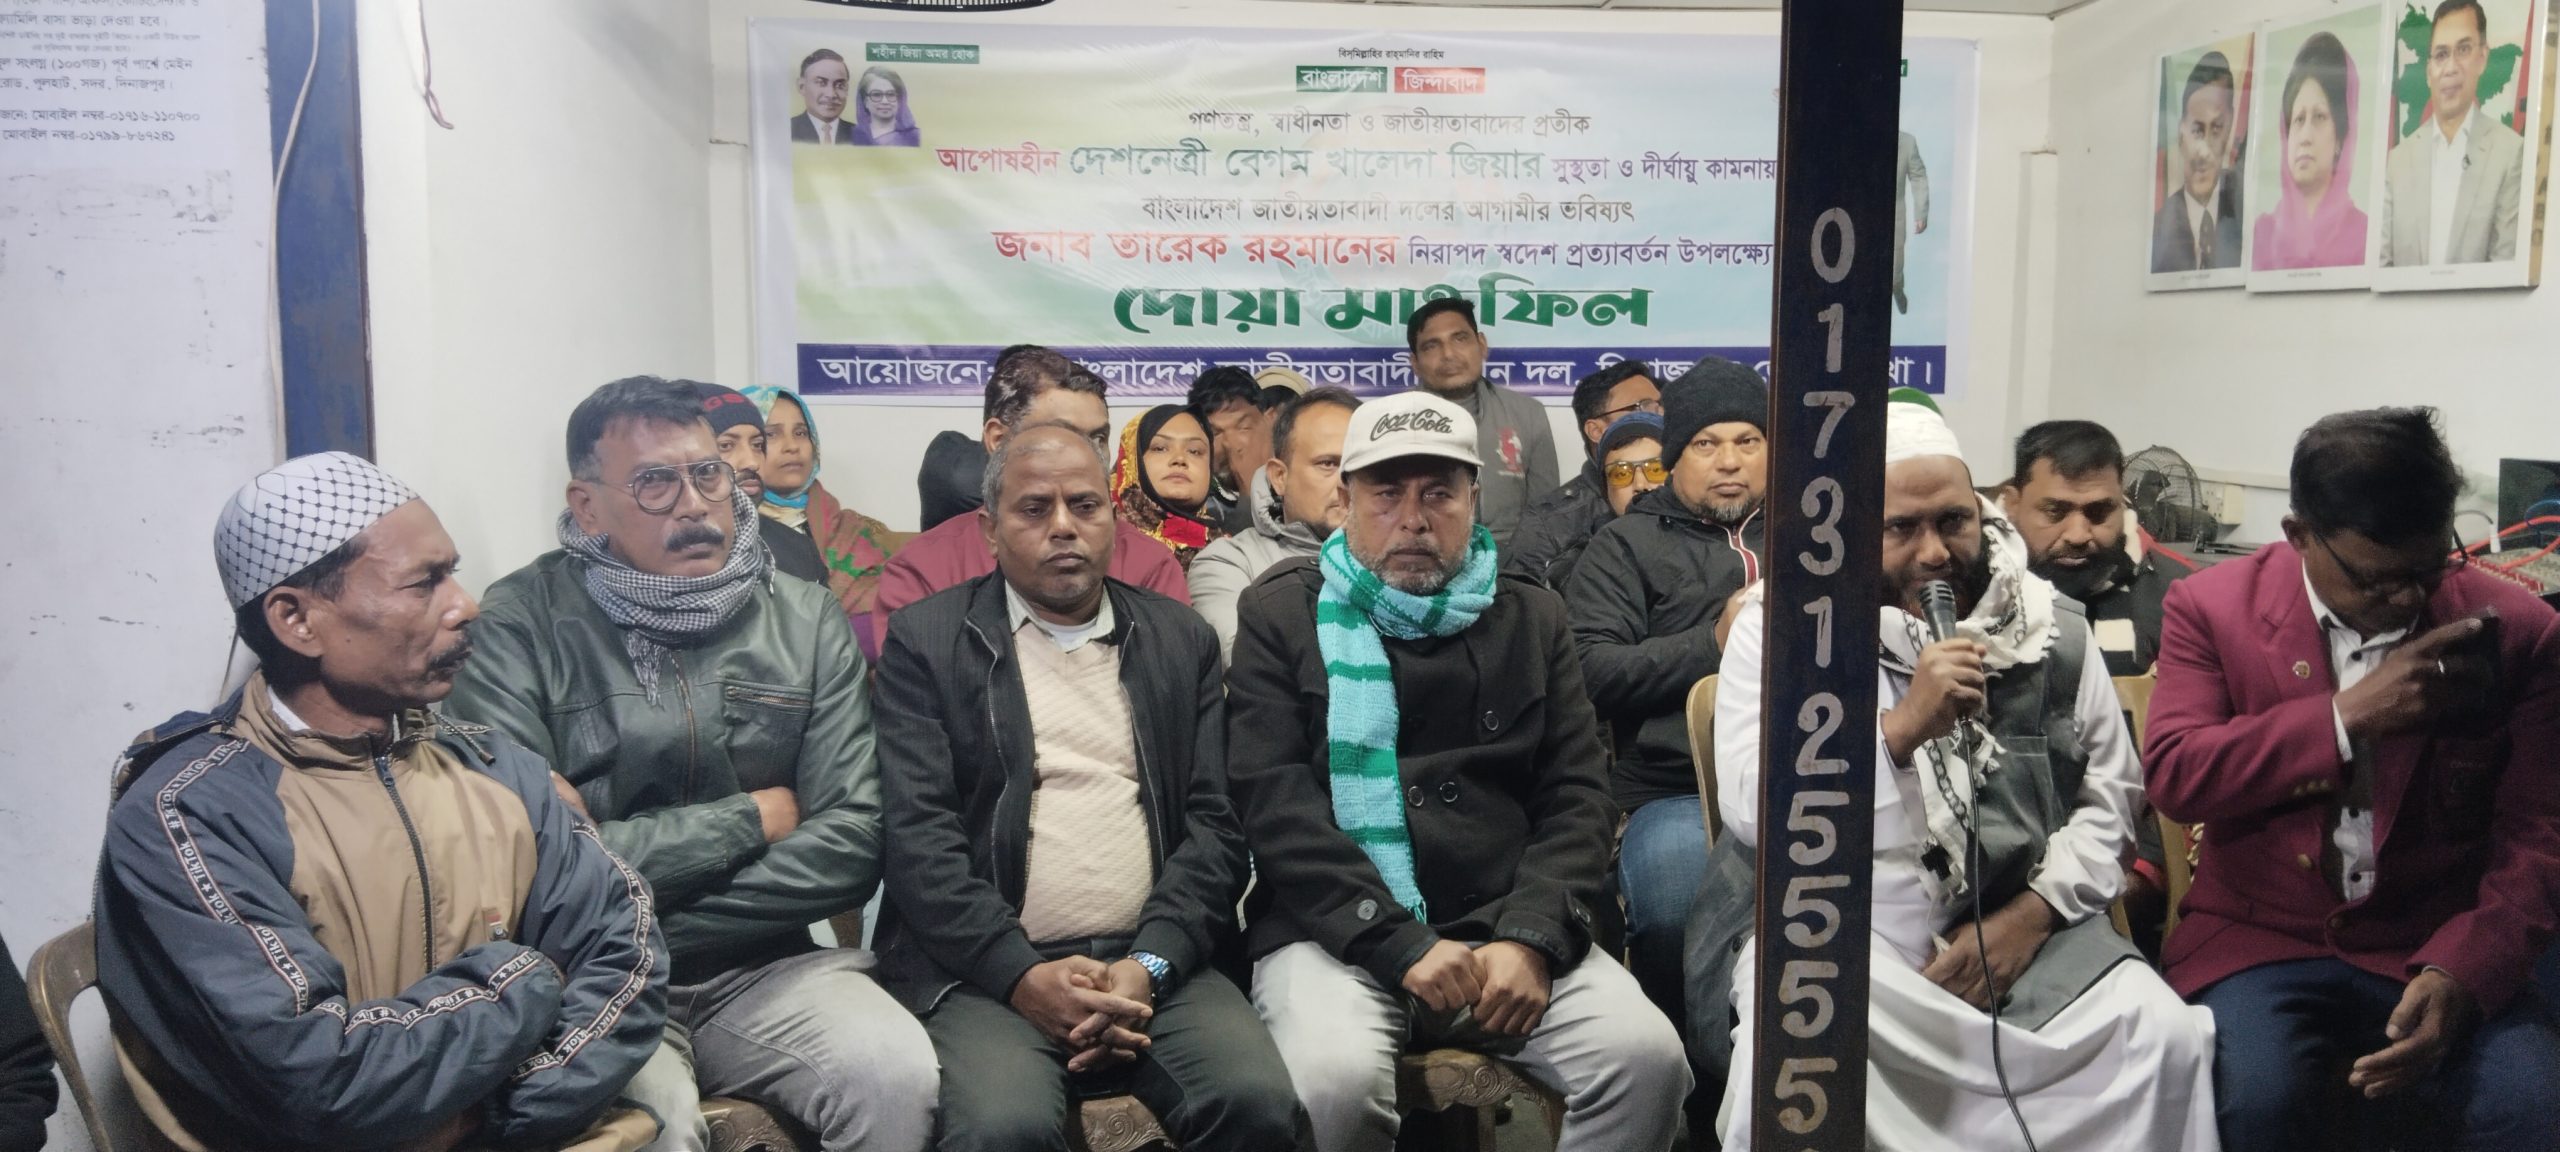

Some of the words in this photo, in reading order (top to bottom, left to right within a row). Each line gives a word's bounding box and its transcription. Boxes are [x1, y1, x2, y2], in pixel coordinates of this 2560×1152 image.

[164, 57, 192, 70] মেইন
[871, 44, 897, 59] শহীদ
[925, 48, 948, 60] অমর
[1300, 68, 1383, 90] বাংলাদেশ
[1402, 68, 1479, 92] জিন্দাবাদ
[33, 108, 77, 120] মোবাইল
[1189, 112, 1260, 137] গণতন্ত্র,
[1271, 108, 1351, 134] স্বাধীনতা
[1360, 115, 1376, 134] ও
[1384, 108, 1525, 135] জাতীয়তাবাদের
[1534, 108, 1592, 137] প্রতীক
[3, 127, 47, 140] মোবাইল
[936, 142, 1061, 176] আপোষহীন
[1069, 138, 1212, 176] দেশনেত্রী
[1226, 147, 1313, 179] বেগম
[1327, 148, 1437, 180] খালেদা
[1446, 142, 1545, 180] জিয়ার
[1551, 157, 1610, 184] সুস্থতা
[1617, 160, 1634, 178] ও
[1641, 151, 1699, 185] দীর্ঘায়ু
[1704, 158, 1777, 180] কামনায়
[1141, 195, 1242, 221] বাংলাদেশ
[1250, 191, 1390, 222] জাতীয়তাবাদী
[1400, 198, 1455, 222] দলের
[1464, 193, 1551, 222] আগামীর
[1560, 194, 1635, 222] ভবিষ্যৎ
[991, 229, 1096, 263] জনাব
[1107, 231, 1231, 264] তারেক
[1243, 232, 1401, 269] রহমানের
[1408, 236, 1488, 266] নিরাপদ
[1496, 241, 1558, 267] স্বদেশ
[1567, 235, 1671, 268] প্রত্যাবর্তন
[1114, 286, 1306, 334] দোয়া
[1775, 207, 1855, 1152] 0173125555
[180, 841, 206, 882] TikTok
[208, 893, 239, 925] ikTok
